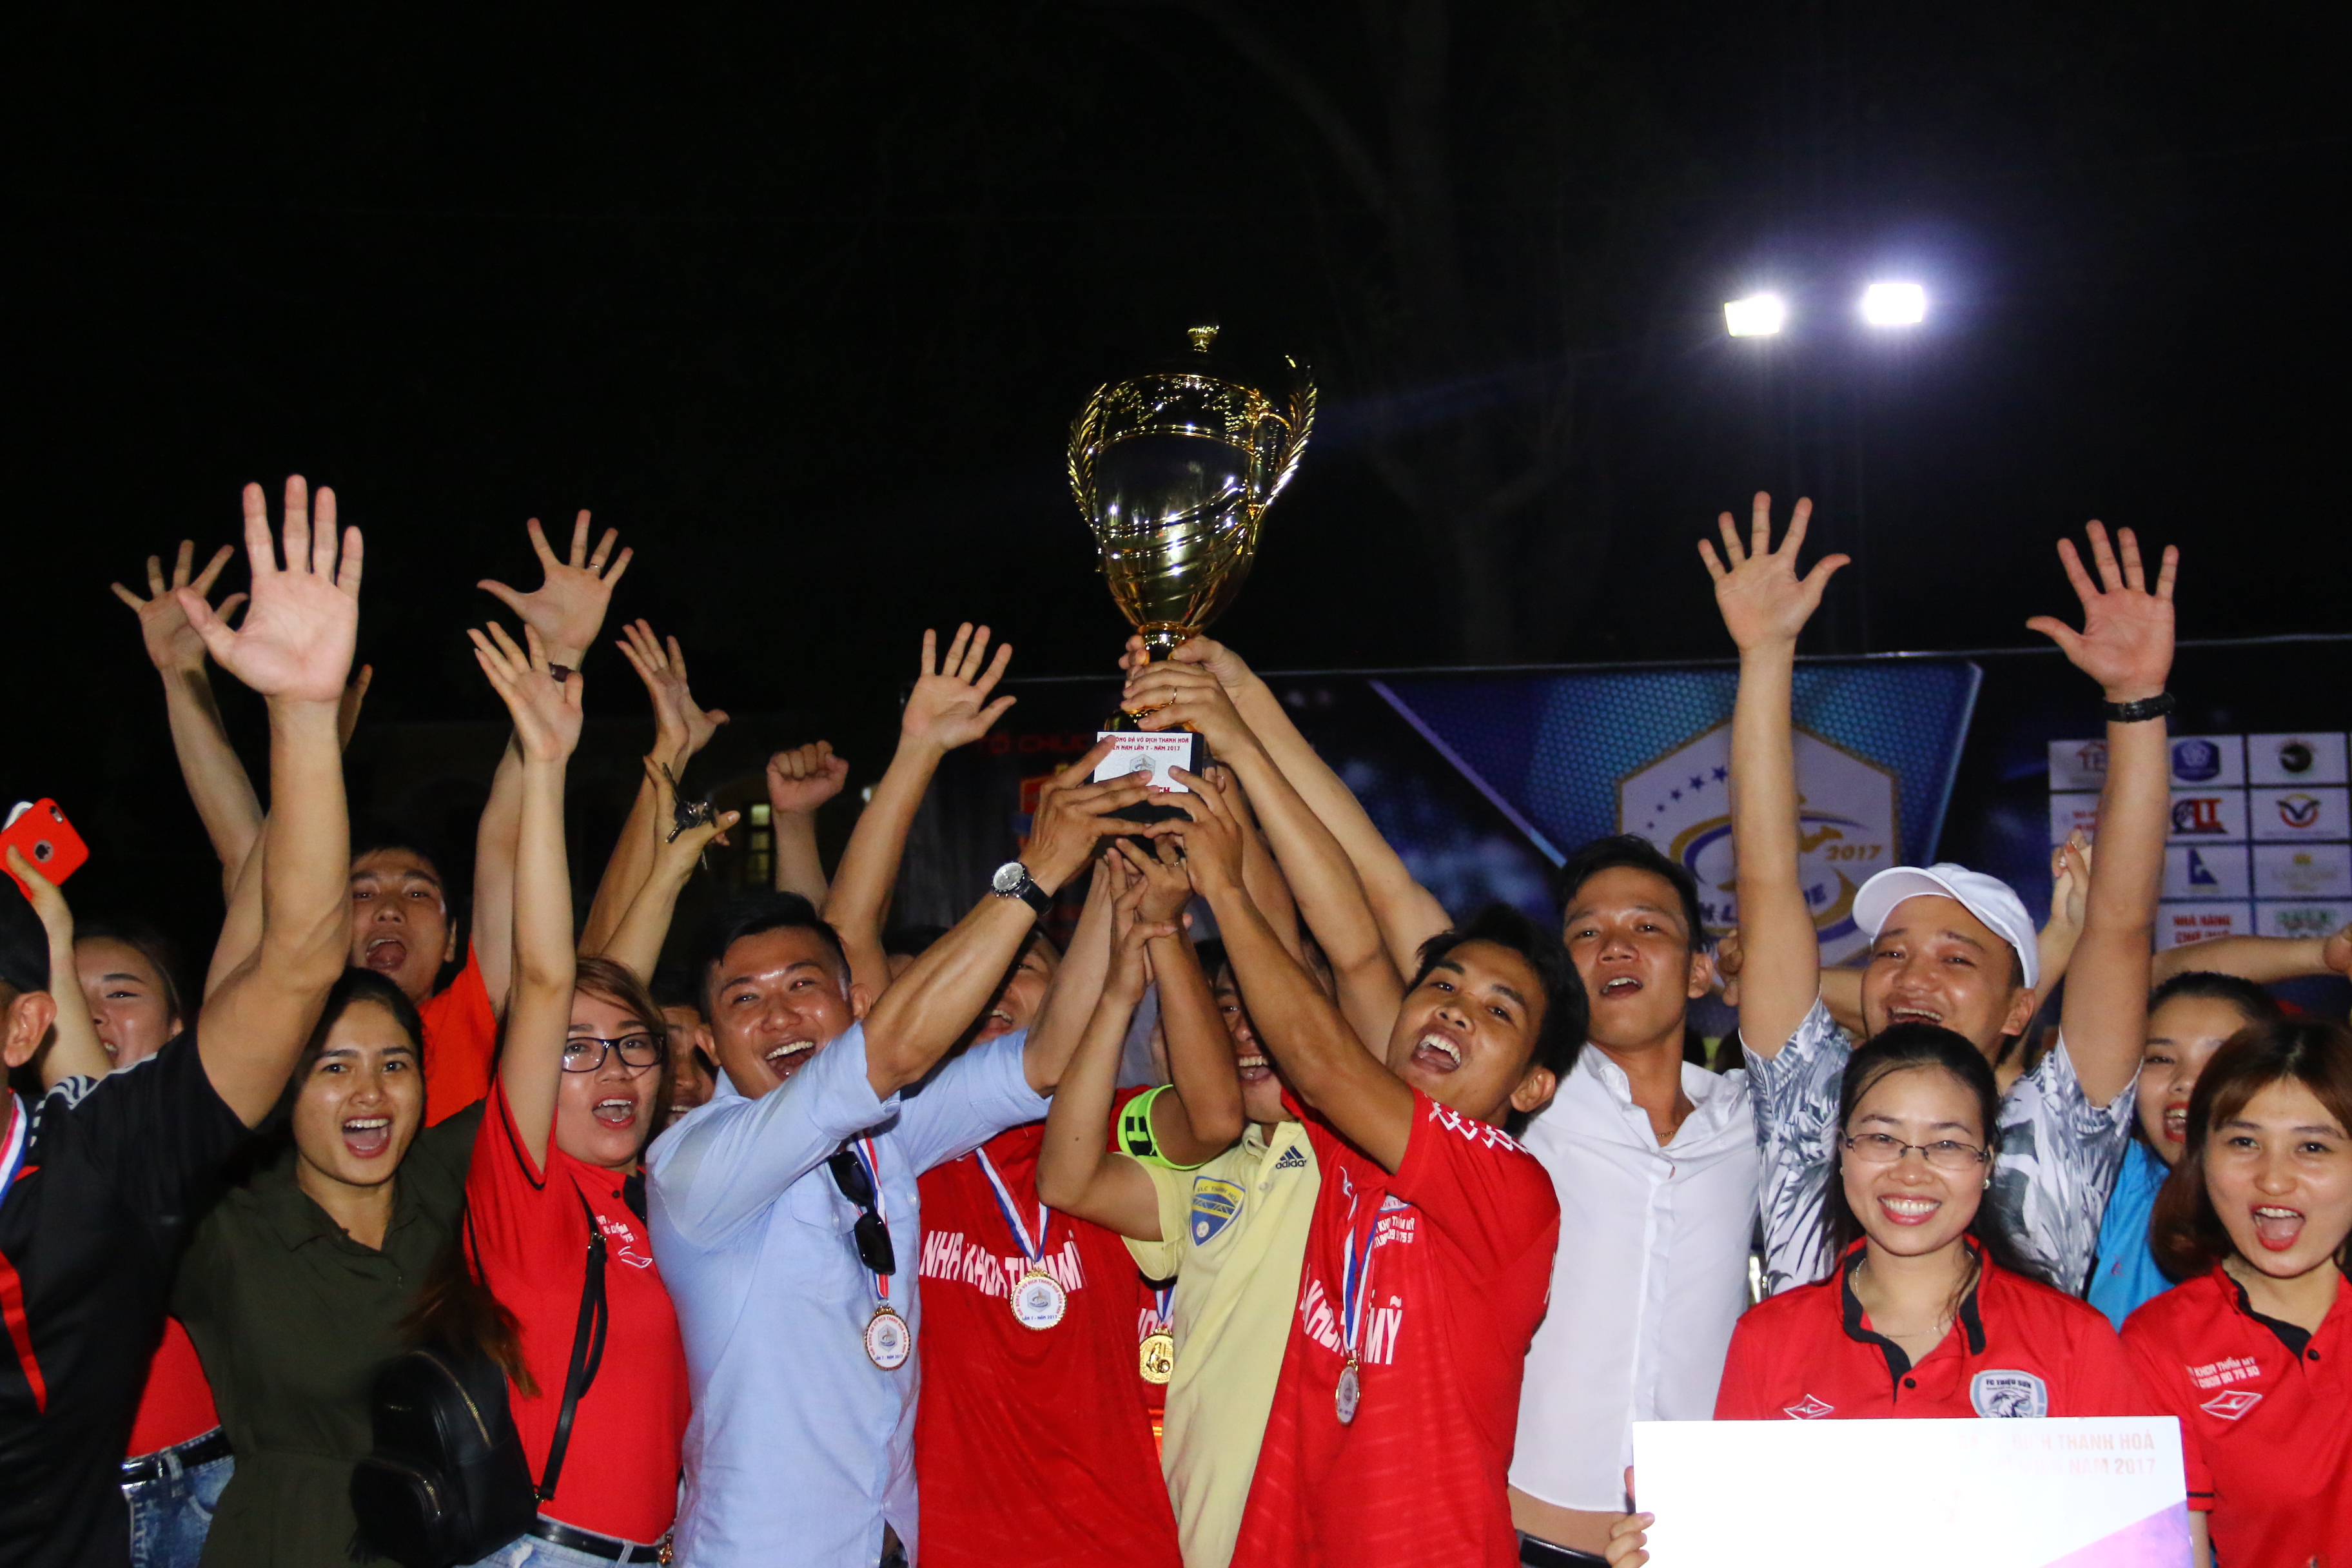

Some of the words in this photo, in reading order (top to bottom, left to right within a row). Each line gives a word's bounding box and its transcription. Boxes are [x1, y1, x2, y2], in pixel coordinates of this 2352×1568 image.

[1825, 845, 1882, 861] 2017
[2059, 1433, 2115, 1451] THANH
[2068, 1456, 2110, 1476] NAM
[2113, 1457, 2156, 1476] 2017
